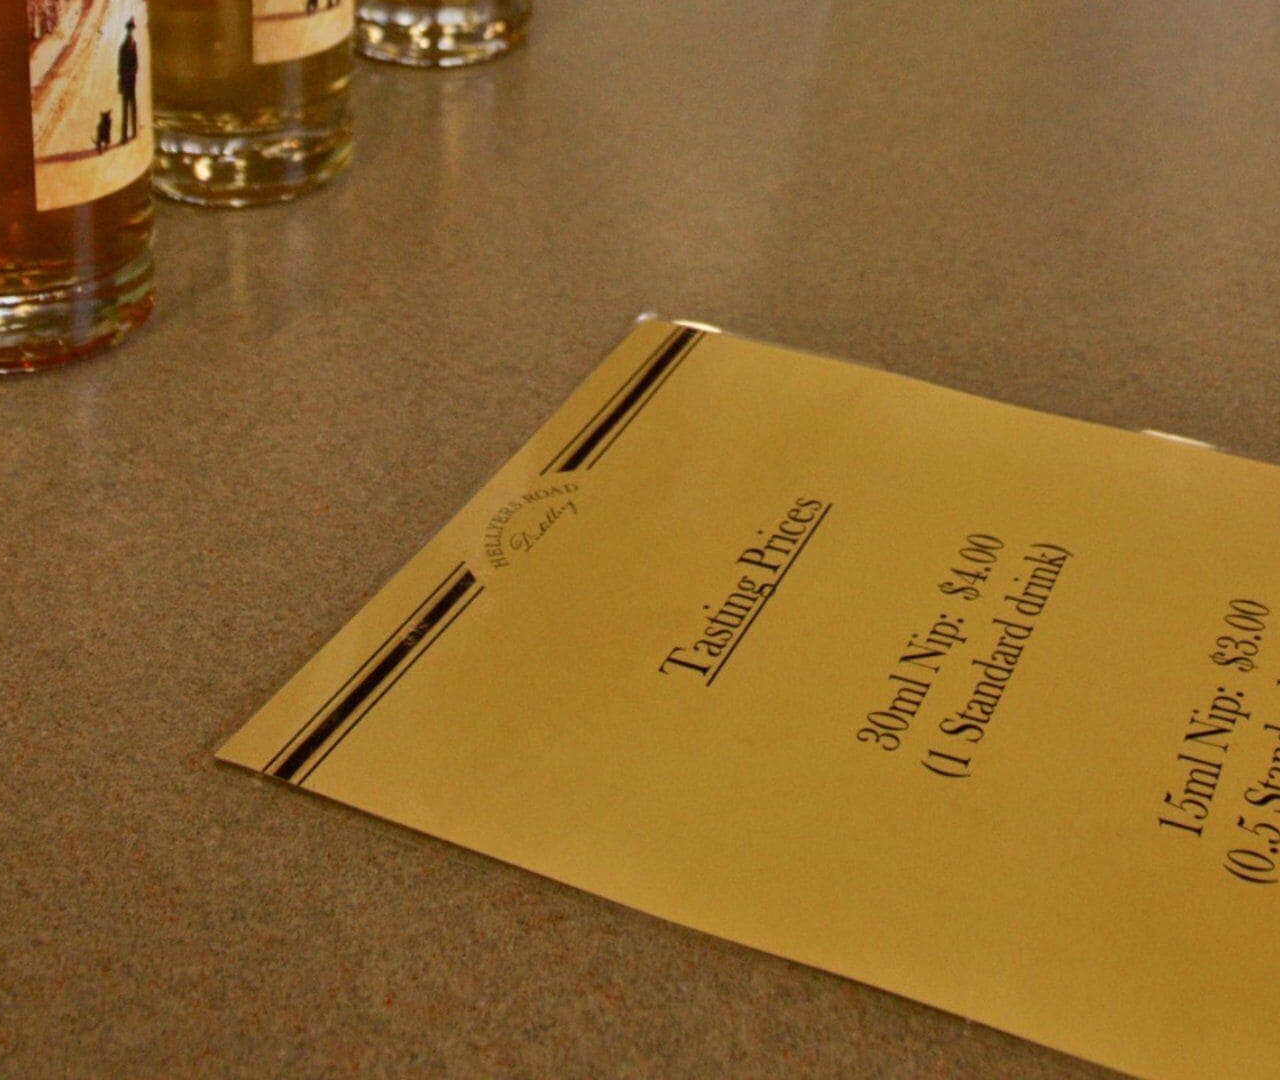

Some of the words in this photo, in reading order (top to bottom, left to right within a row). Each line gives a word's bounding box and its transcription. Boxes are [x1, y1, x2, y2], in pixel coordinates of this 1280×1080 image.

[484, 502, 523, 570] HELLYERS
[522, 483, 579, 503] ROAD
[658, 575, 776, 679] Tasting
[736, 496, 822, 574] Prices
[1004, 543, 1075, 618] drink)
[856, 673, 931, 752] 30ml
[898, 613, 968, 675] Nip:
[937, 533, 1005, 601] $4.00
[1209, 598, 1271, 673] $3.00
[939, 618, 1034, 744] Standard
[1184, 686, 1251, 752] Nip:
[920, 749, 972, 780] (1
[1157, 754, 1222, 838] 15ml
